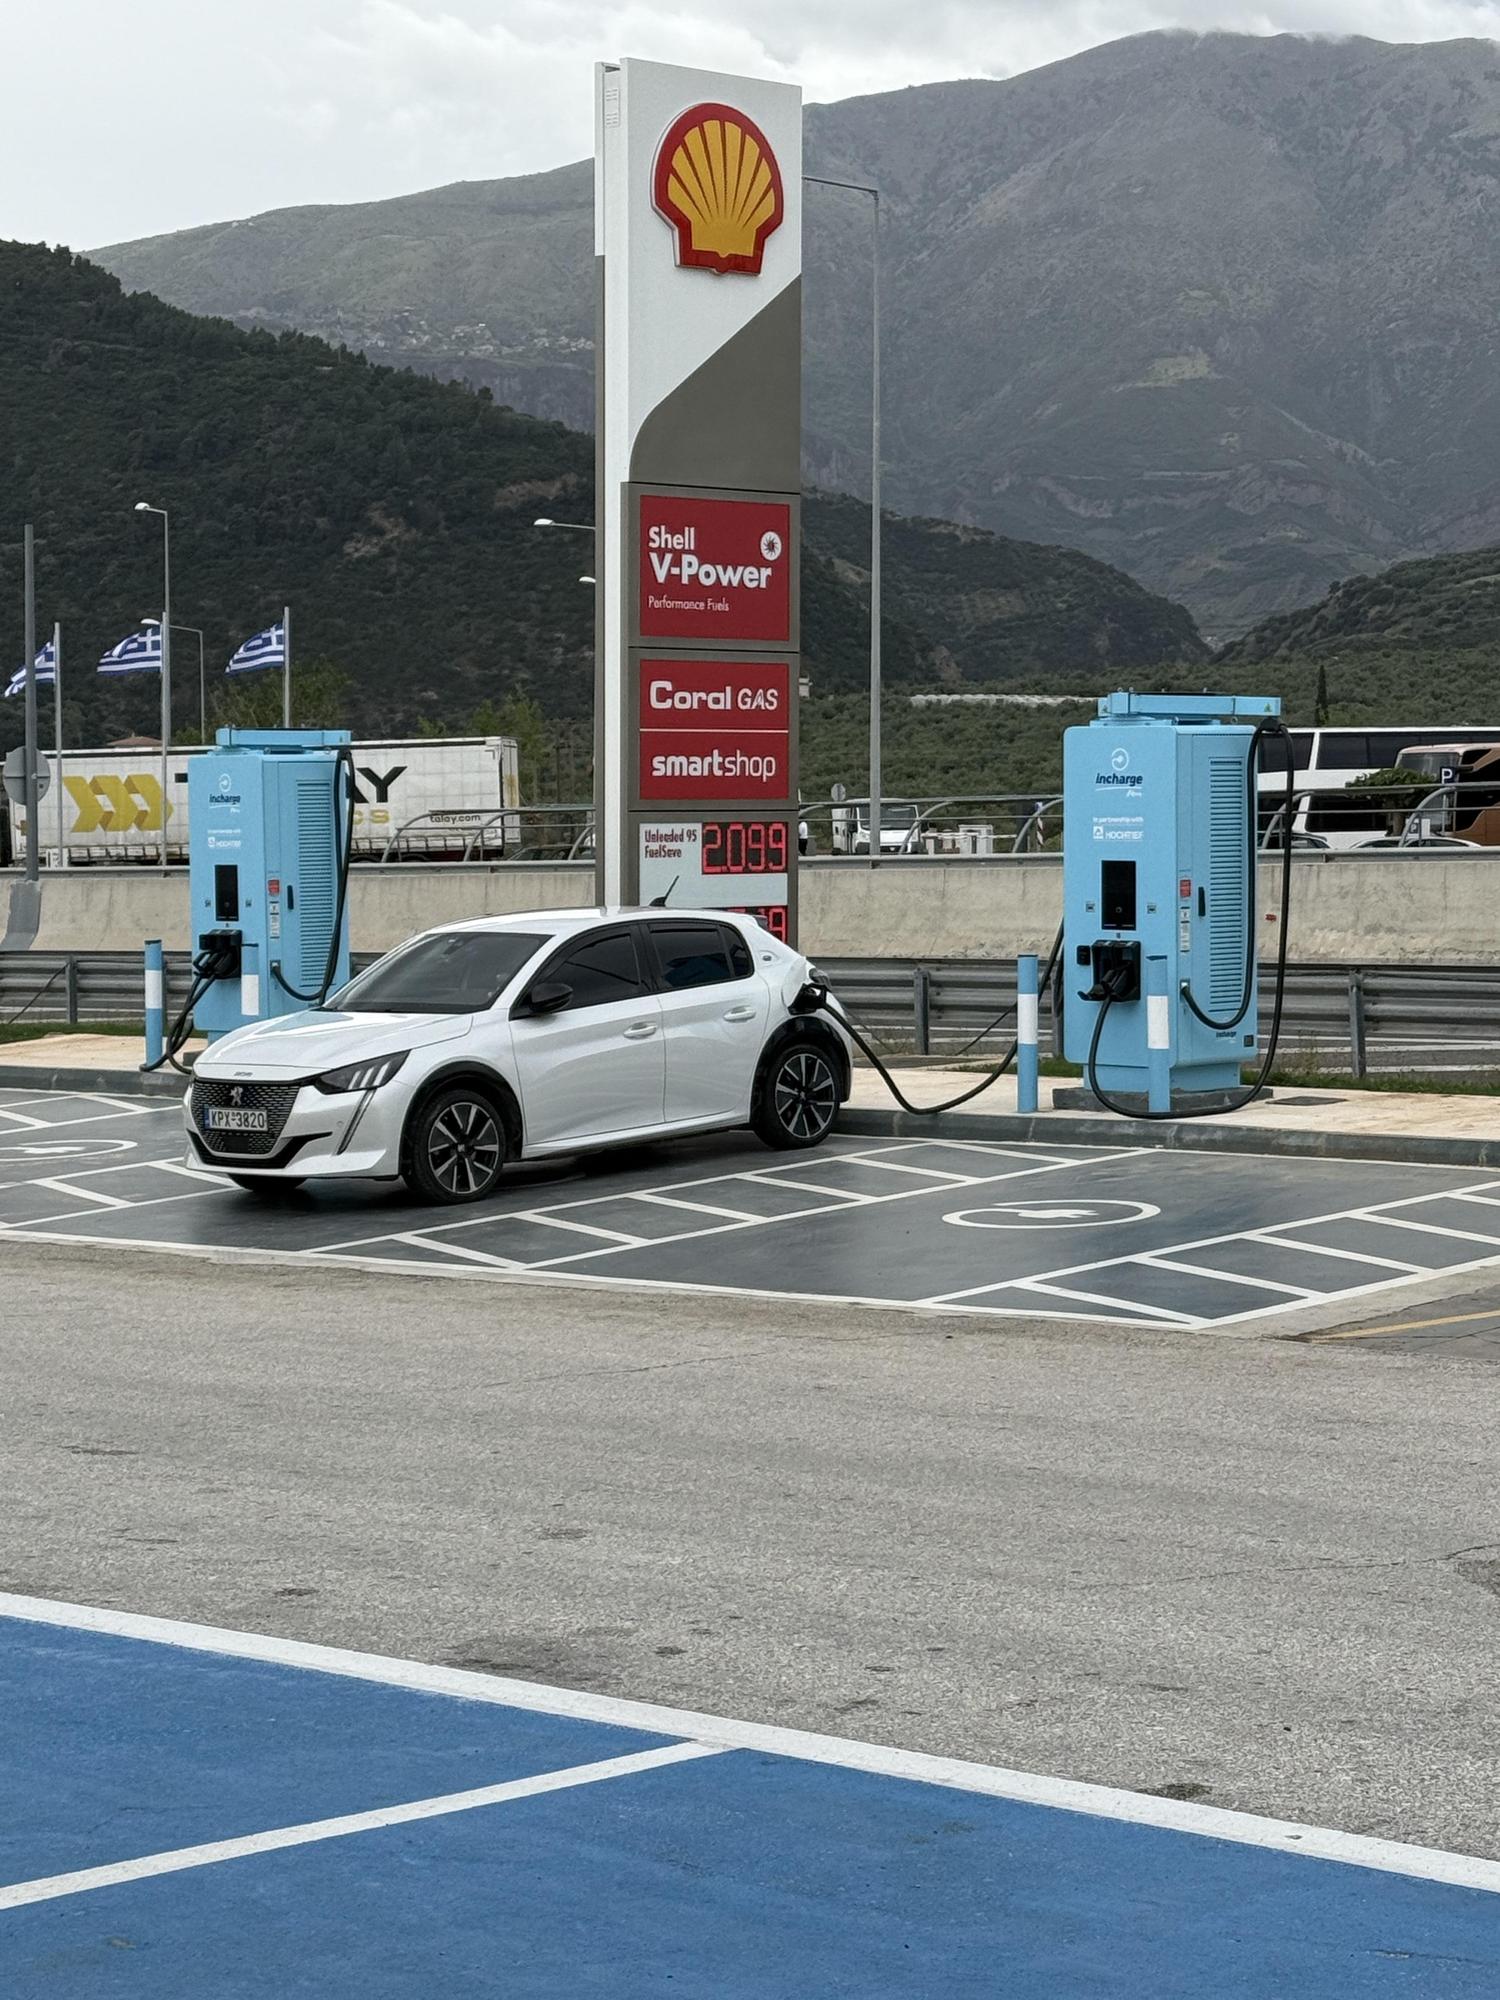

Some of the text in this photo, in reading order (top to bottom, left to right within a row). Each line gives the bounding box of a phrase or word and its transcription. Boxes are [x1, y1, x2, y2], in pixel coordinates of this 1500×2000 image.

[649, 525, 695, 550] Shell
[649, 552, 772, 589] V-Power
[648, 595, 729, 612] Performance Fuels
[650, 680, 778, 711] Coral GAS
[652, 749, 776, 783] smartshop
[1095, 772, 1143, 787] incharge
[1441, 768, 1453, 784] P
[645, 828, 697, 843] Unleaded 95
[645, 844, 682, 859] FuelSave
